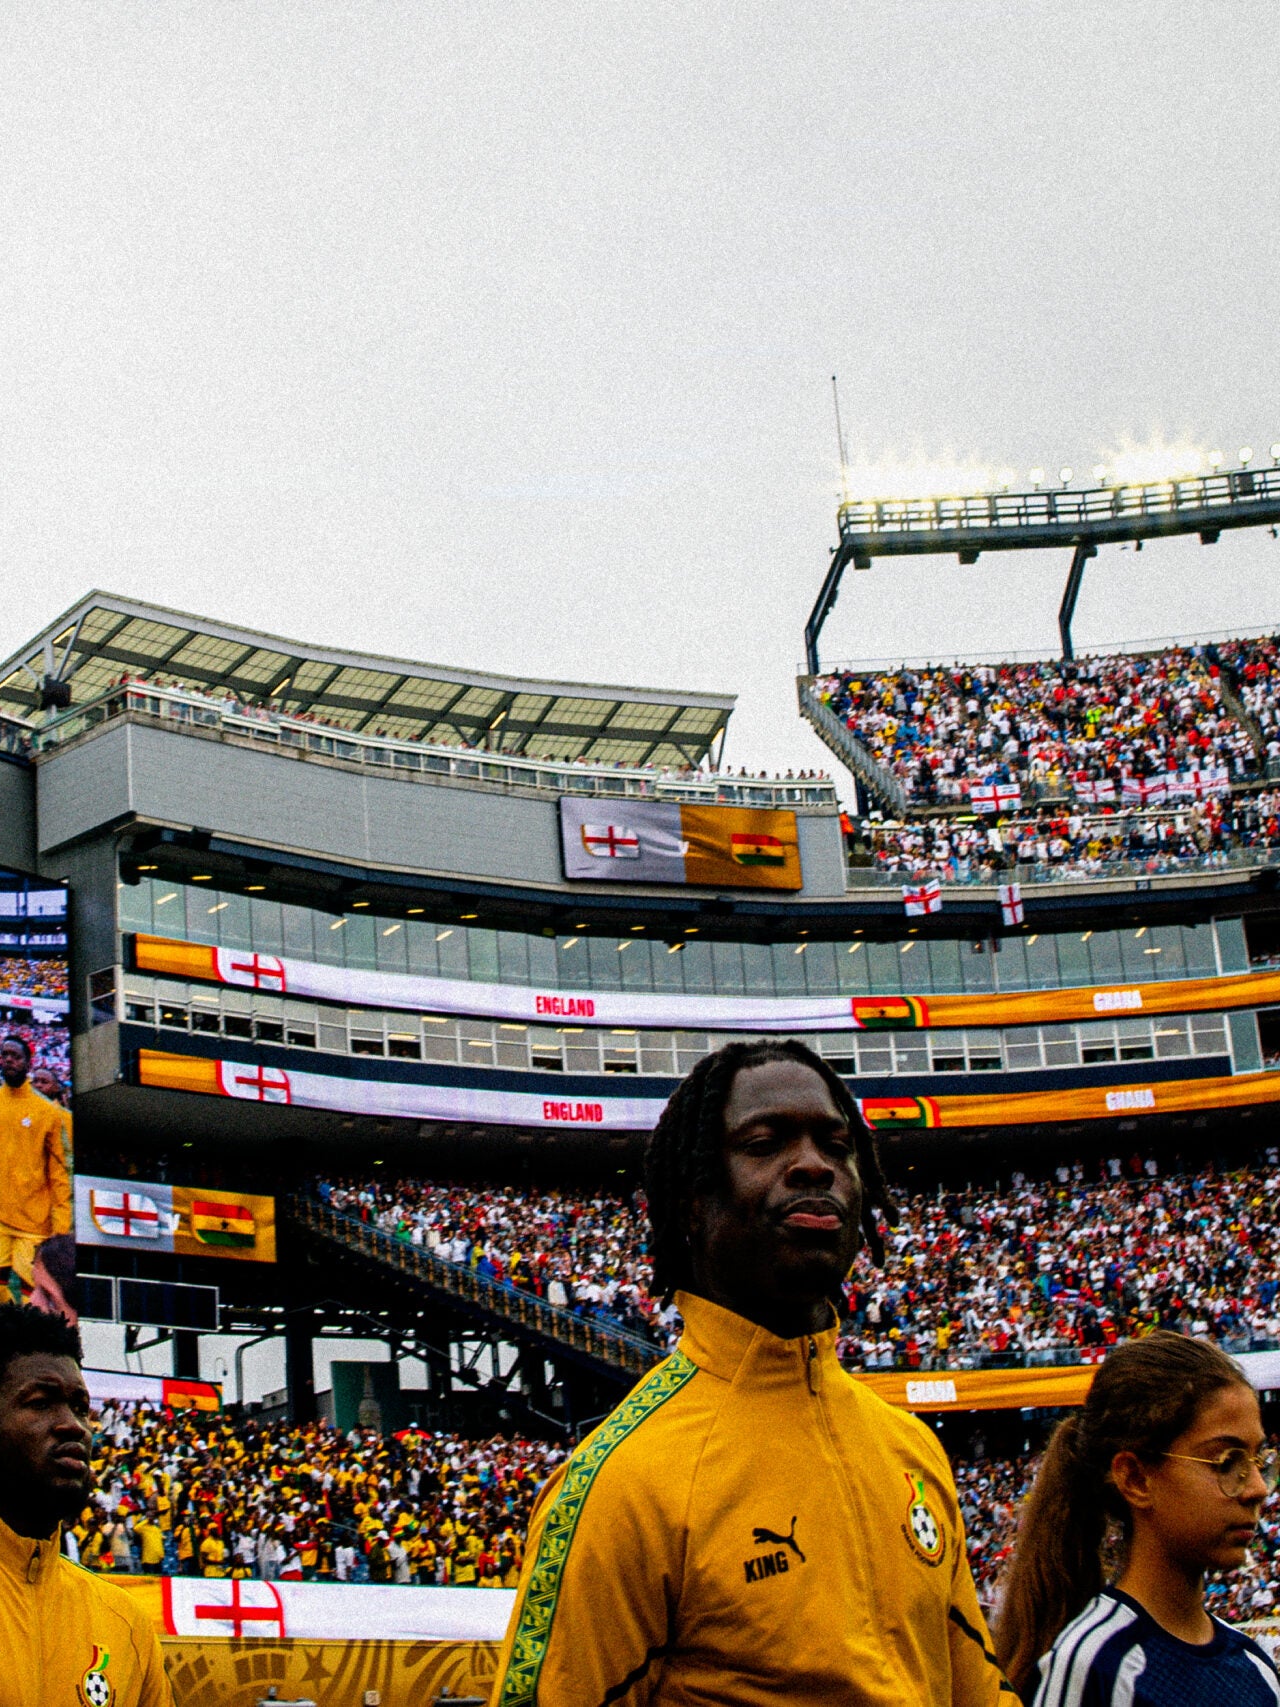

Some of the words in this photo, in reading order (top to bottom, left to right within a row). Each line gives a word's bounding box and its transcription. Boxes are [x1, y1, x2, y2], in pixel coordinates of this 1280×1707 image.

[536, 996, 595, 1017] ENGLAND
[543, 1101, 603, 1122] ENGLAND
[744, 1551, 789, 1583] KING
